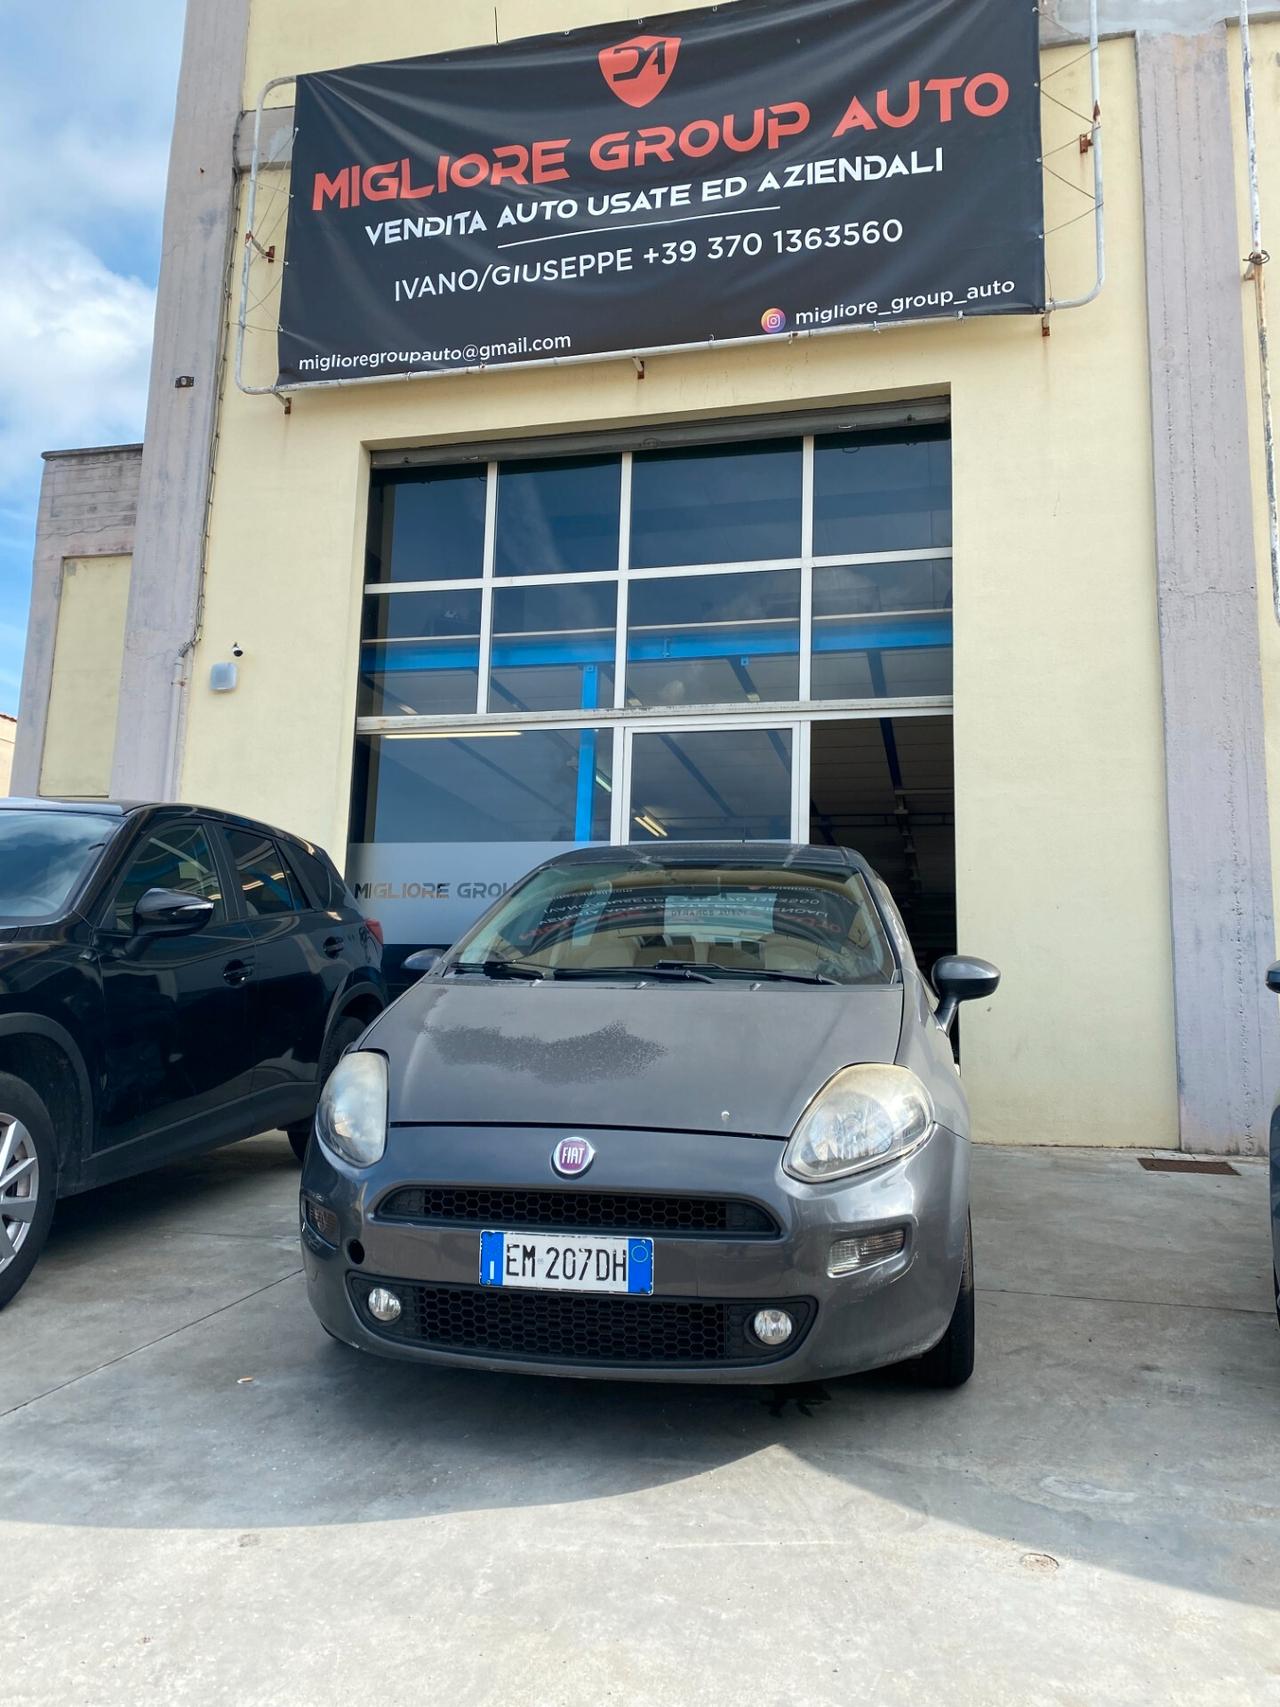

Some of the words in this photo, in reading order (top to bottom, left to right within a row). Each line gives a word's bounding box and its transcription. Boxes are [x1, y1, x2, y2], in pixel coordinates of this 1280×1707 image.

[312, 139, 571, 211] MIGLIORE
[589, 101, 810, 171] GROUP
[832, 72, 1009, 137] AUTO
[365, 210, 487, 246] VENDITA
[496, 199, 578, 229] AUTO
[587, 183, 692, 216] USATE
[701, 176, 748, 201] ED
[757, 147, 943, 192] AZIENDALI
[395, 247, 633, 302] IVANO/GIUSEPPE
[643, 240, 697, 265] +39
[707, 233, 763, 260] 370
[772, 218, 903, 254] 1363560
[795, 279, 1015, 325] migliore_group_auto
[299, 334, 571, 371] miglioregroupauto@gmail.com
[354, 882, 450, 899] MIGLIORE
[561, 1147, 585, 1164] FIAT
[506, 1243, 536, 1277] EM
[545, 1246, 627, 1282] 207DH
